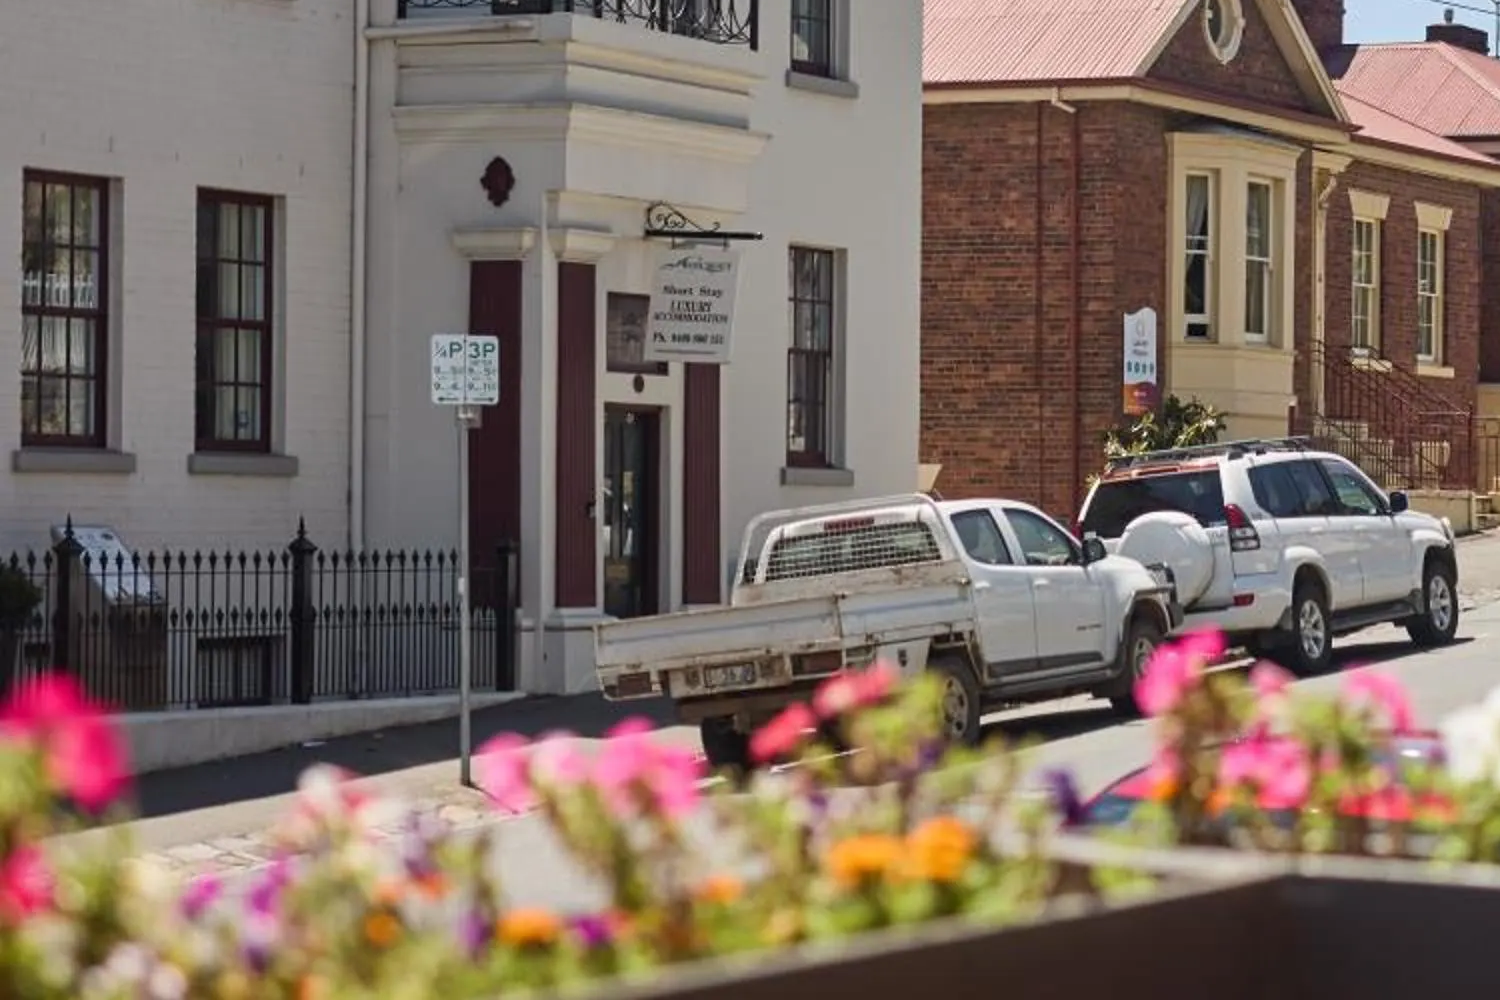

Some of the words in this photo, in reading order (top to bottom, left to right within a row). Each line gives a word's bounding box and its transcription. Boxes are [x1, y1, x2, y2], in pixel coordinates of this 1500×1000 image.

[663, 285, 693, 296] Short
[699, 286, 722, 298] Stay
[671, 300, 712, 312] LUXURY
[468, 342, 496, 358] 3P
